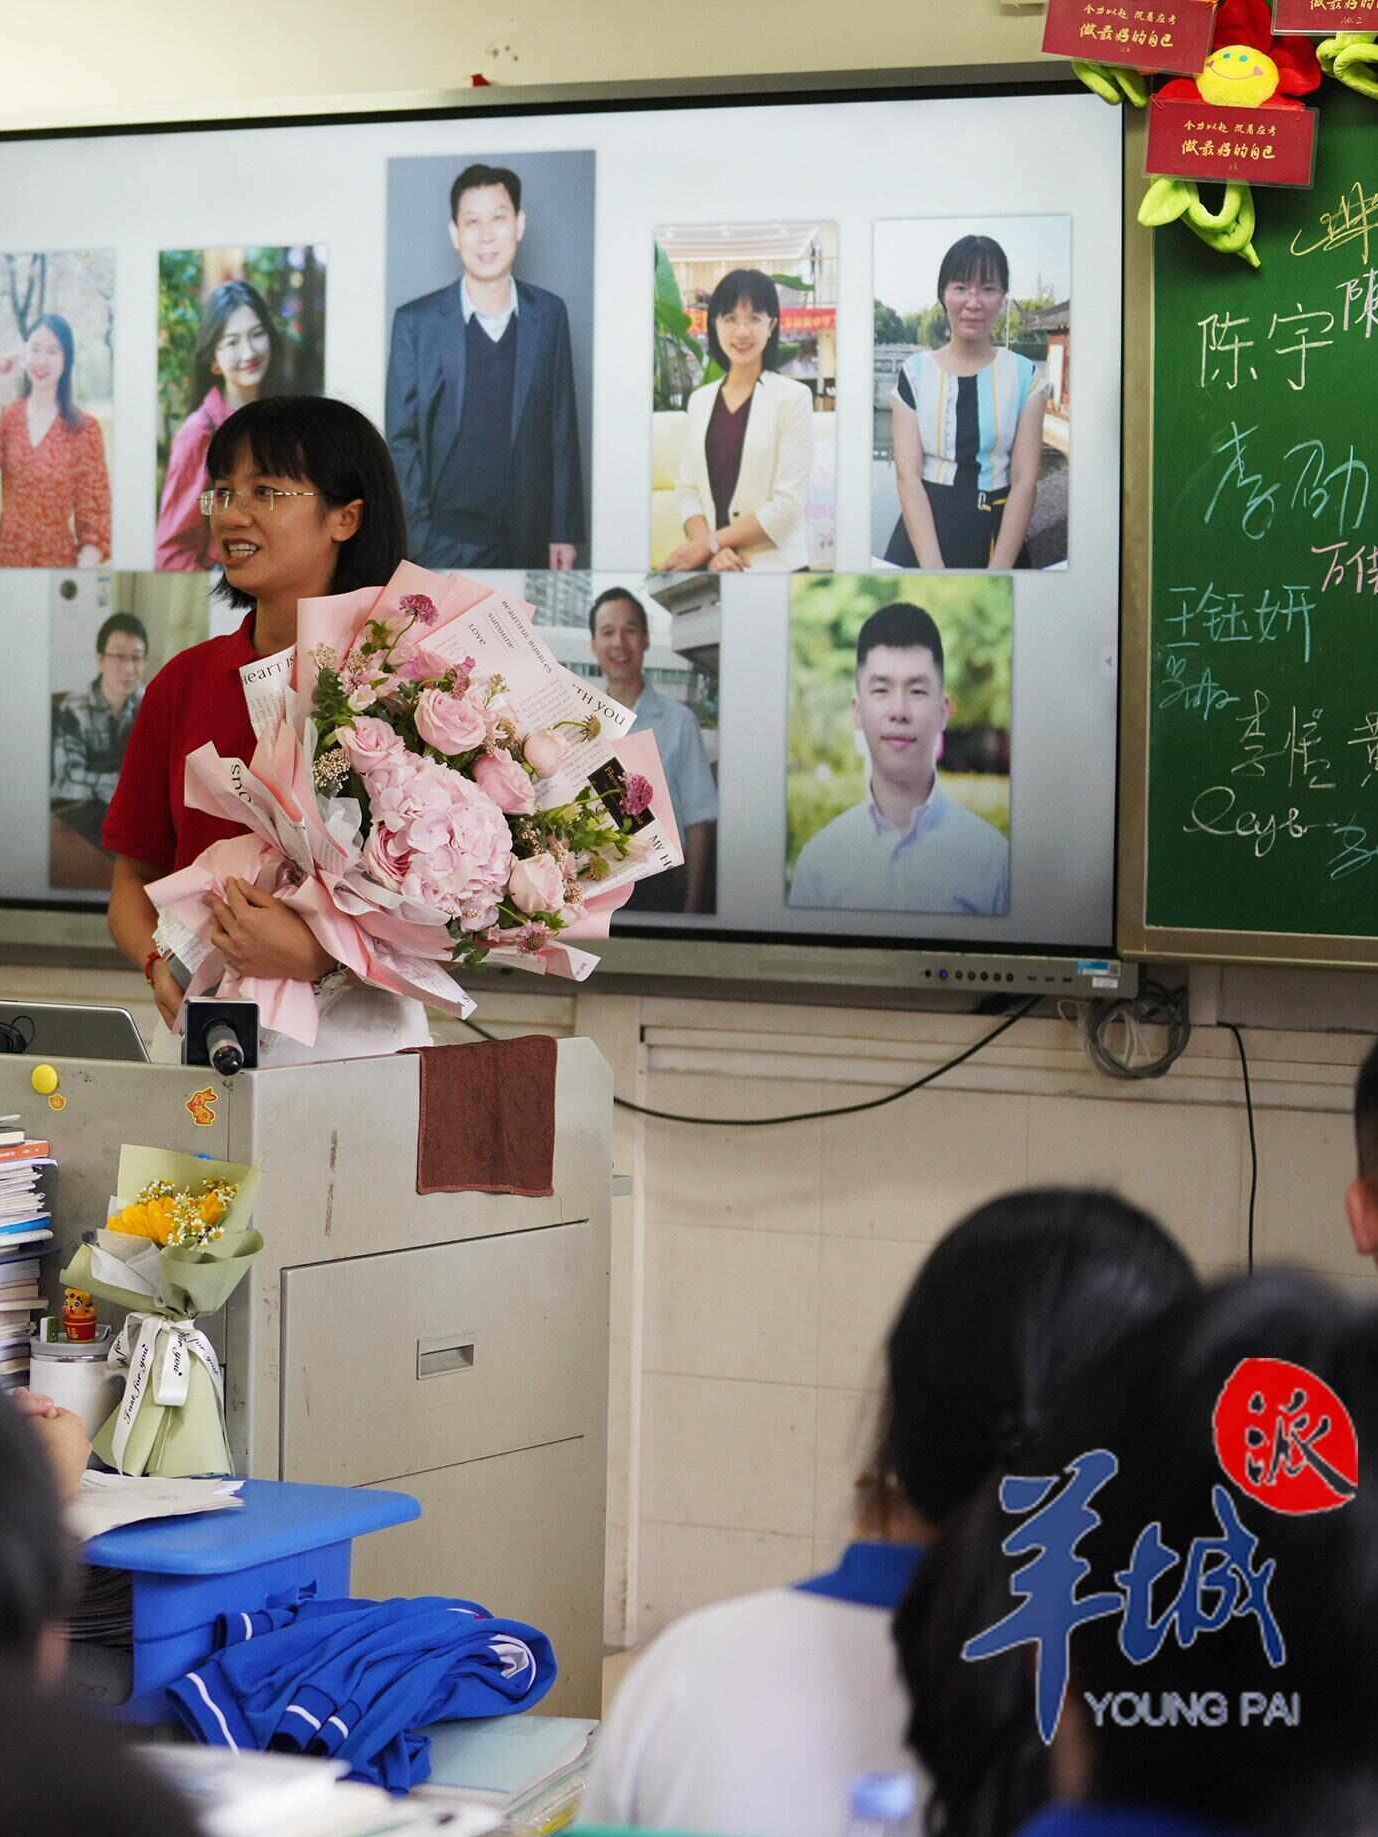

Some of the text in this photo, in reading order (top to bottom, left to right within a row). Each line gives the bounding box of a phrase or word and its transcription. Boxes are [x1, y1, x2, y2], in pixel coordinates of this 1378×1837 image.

[1079, 22, 1174, 48] 做最好的自己
[1182, 138, 1276, 160] 做最好的自己
[1197, 303, 1335, 391] 陈宇
[1165, 582, 1316, 663] 王钰妍
